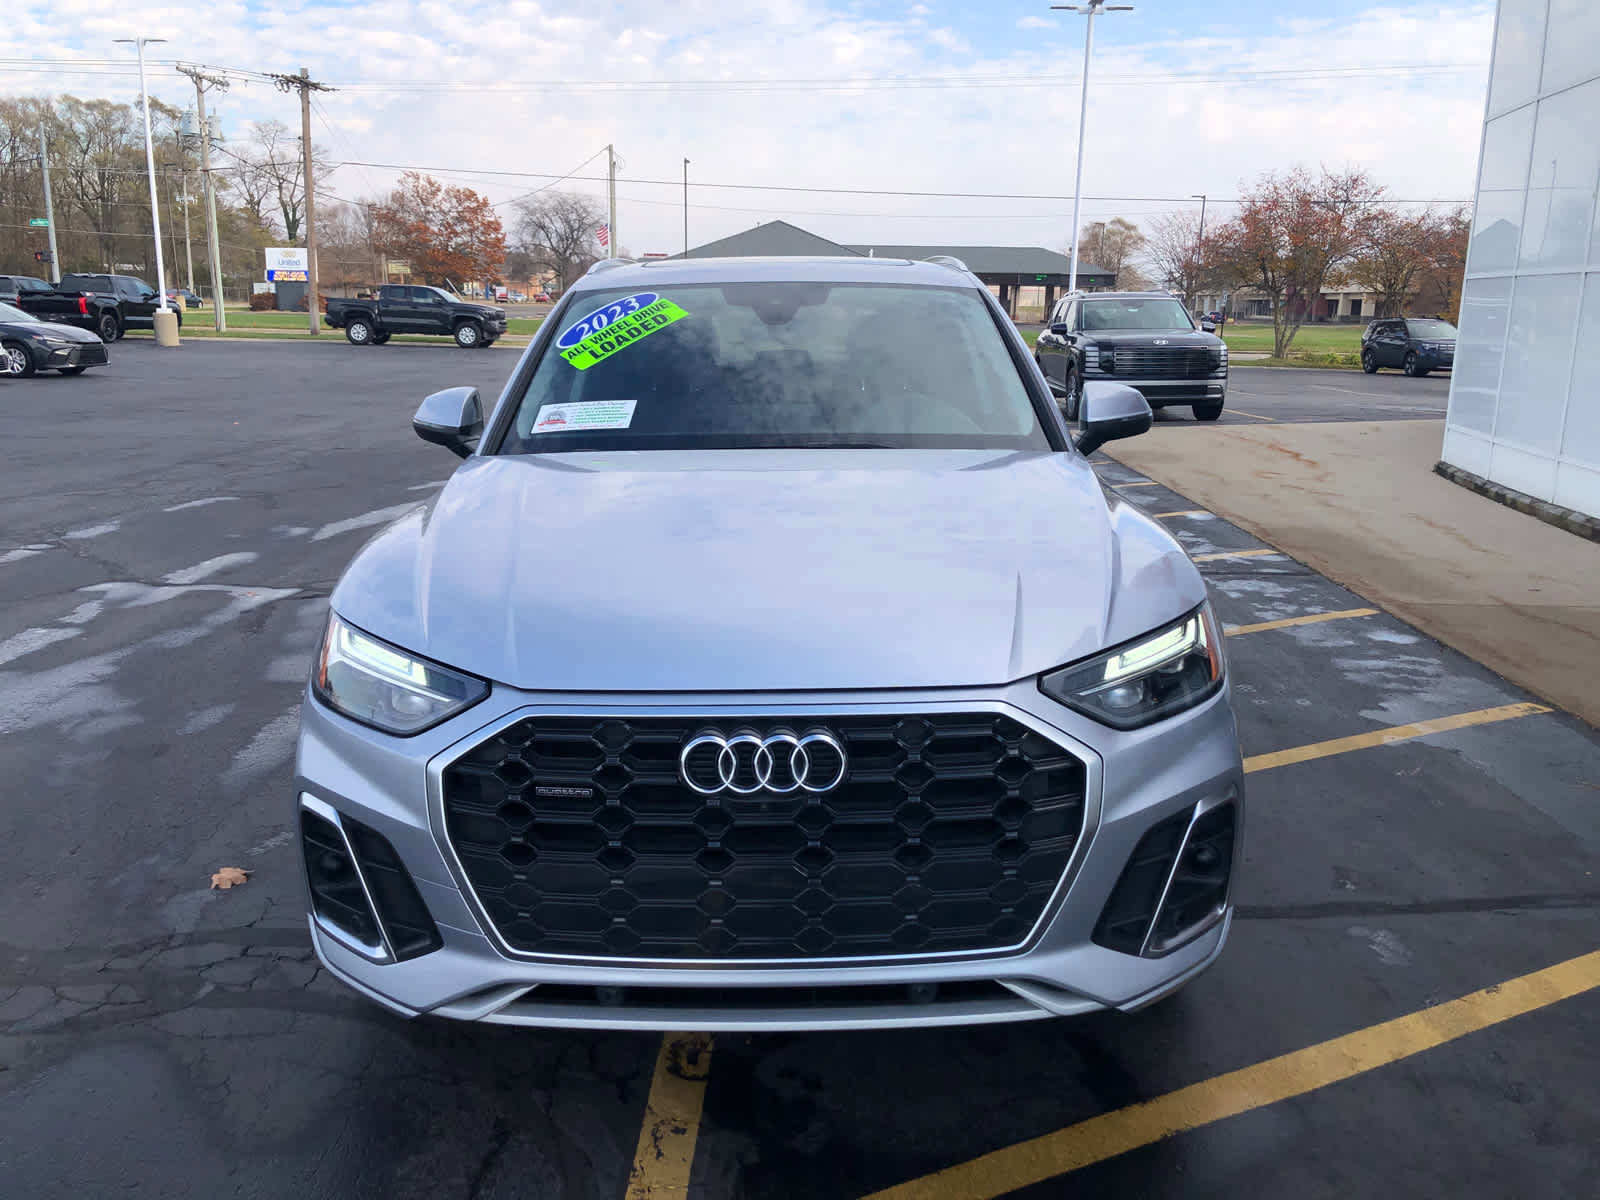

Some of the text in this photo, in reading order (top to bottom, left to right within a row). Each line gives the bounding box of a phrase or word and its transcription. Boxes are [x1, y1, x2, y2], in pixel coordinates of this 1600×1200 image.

[567, 301, 669, 360] ALL WHEEL DRIVE
[576, 297, 640, 340] 2023
[588, 313, 668, 360] LOADED
